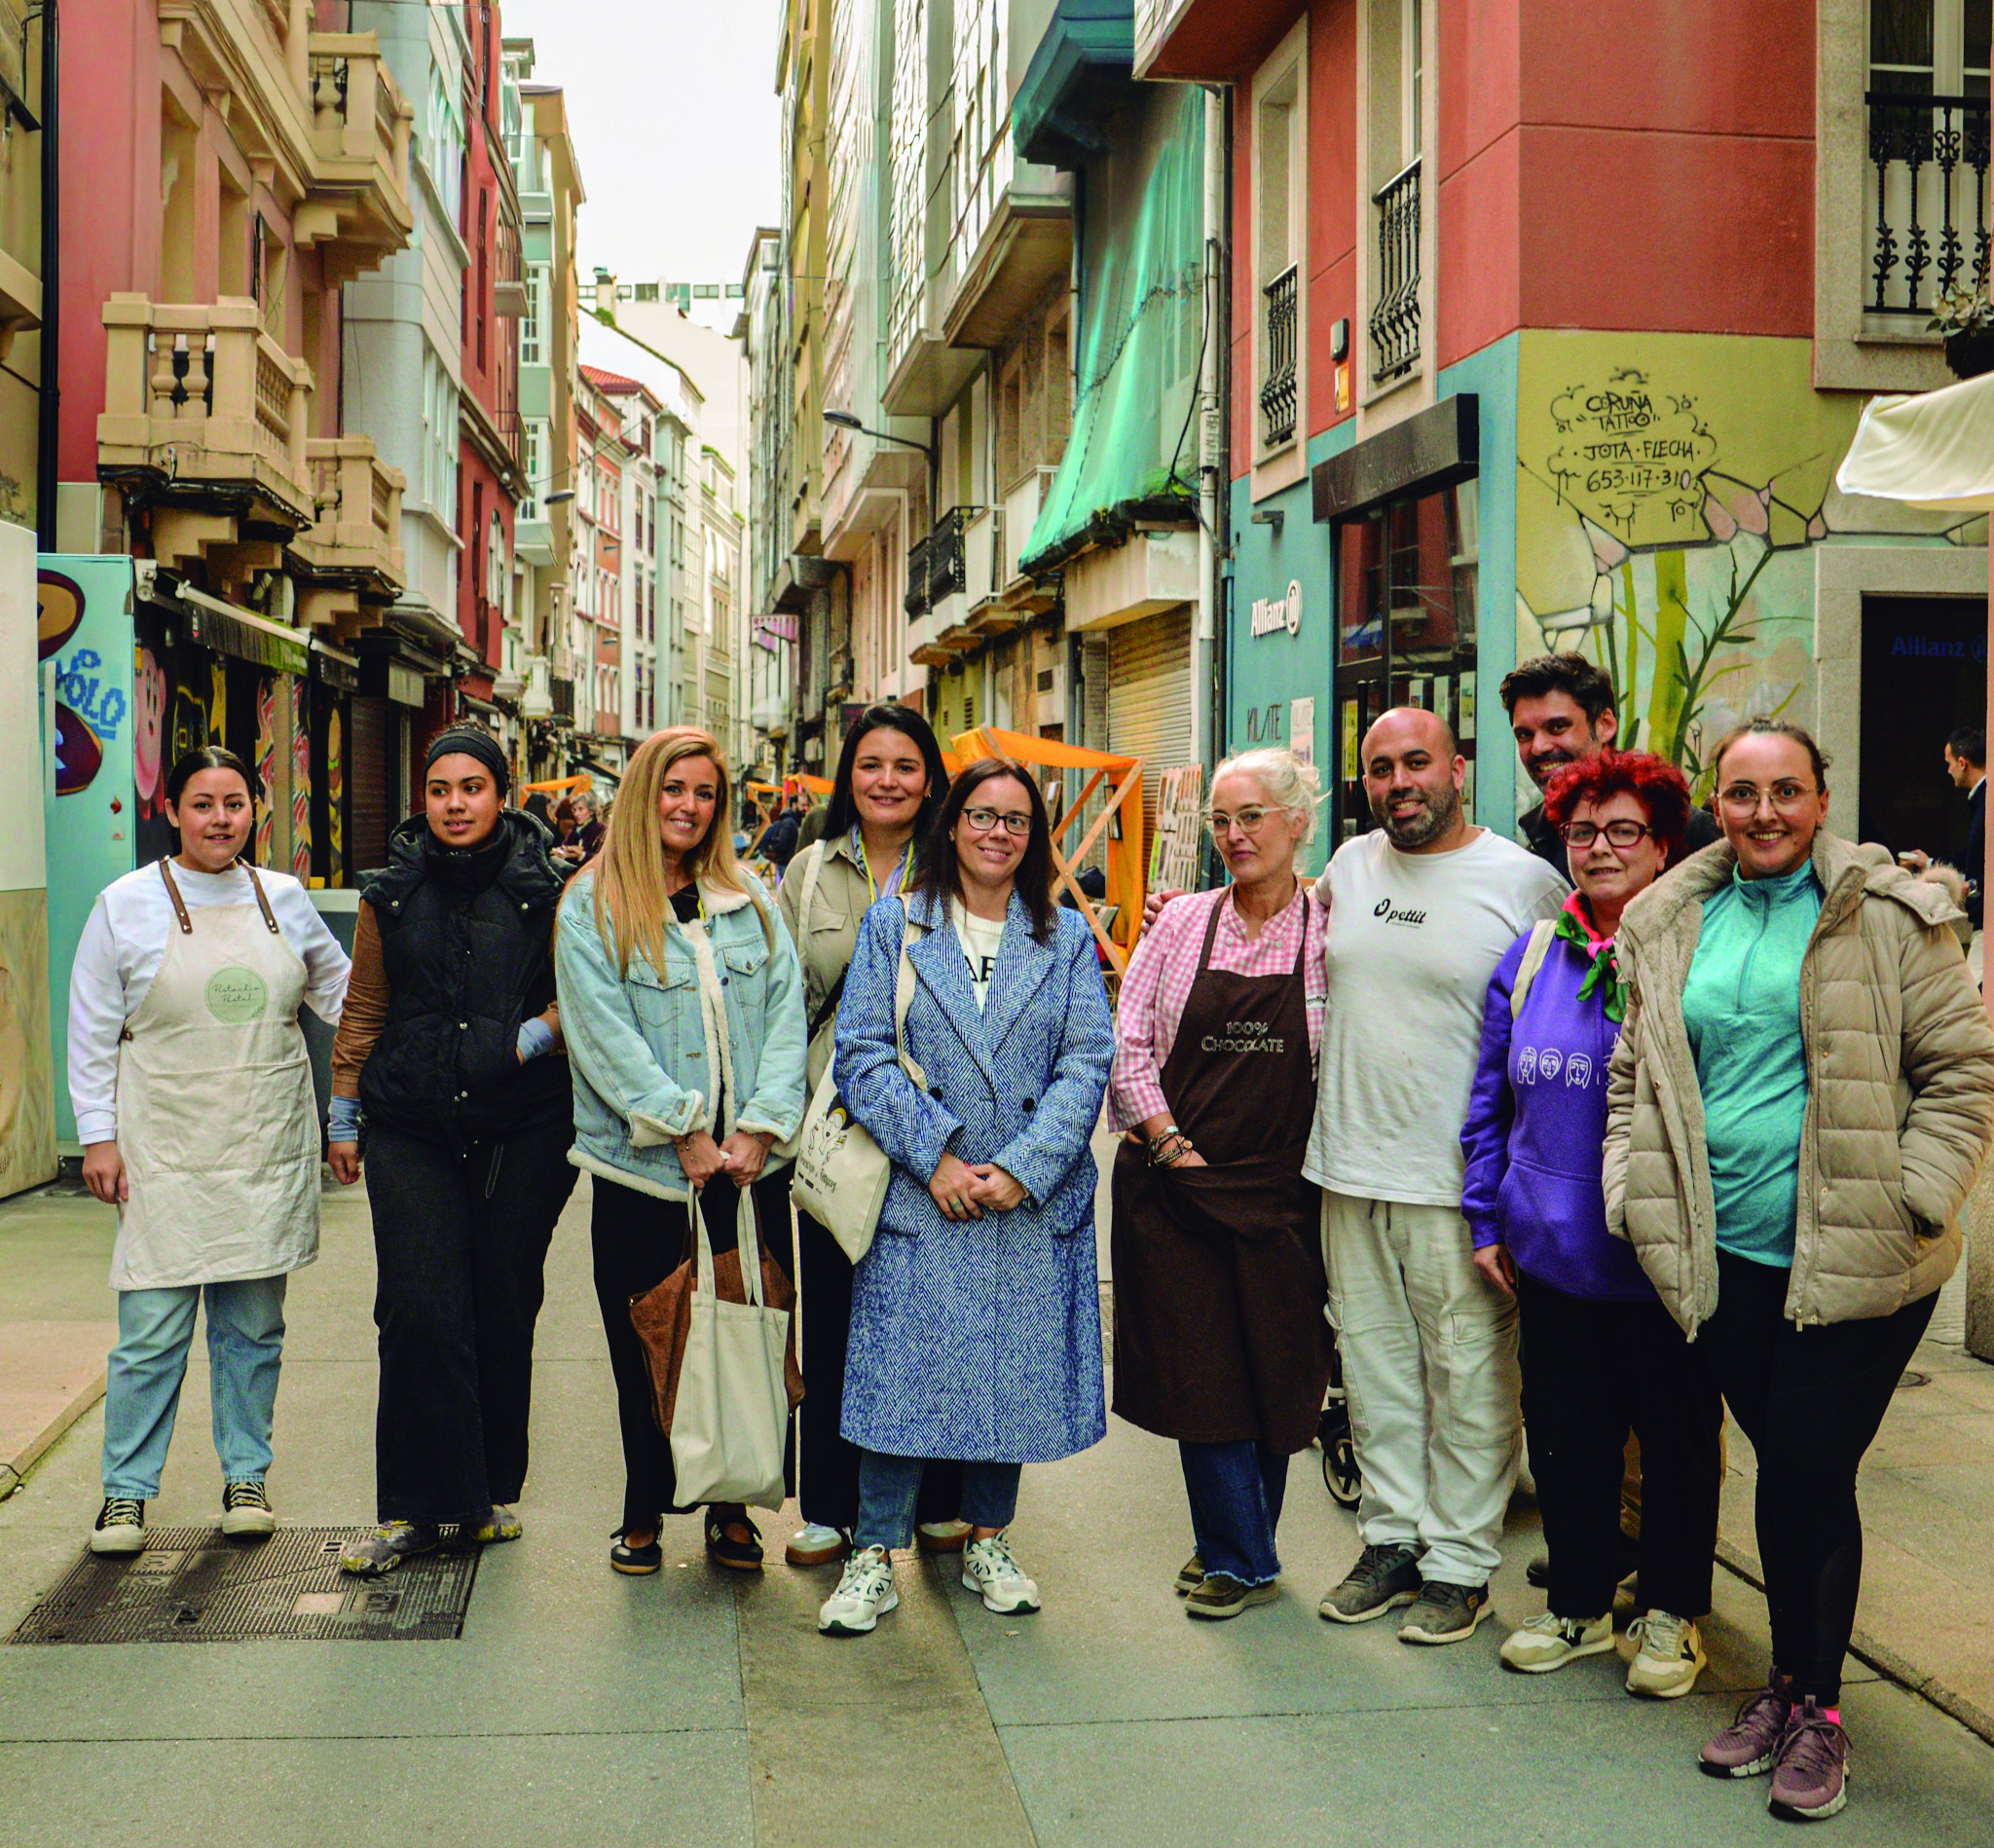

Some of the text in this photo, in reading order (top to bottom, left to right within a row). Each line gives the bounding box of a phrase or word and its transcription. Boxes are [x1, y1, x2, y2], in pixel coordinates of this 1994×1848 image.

[1586, 390, 1653, 413] CORUÑA
[1583, 441, 1634, 461] JOTA
[1250, 598, 1287, 637] Allianz
[1891, 636, 1965, 657] Allianz
[1226, 1021, 1269, 1036] 100%
